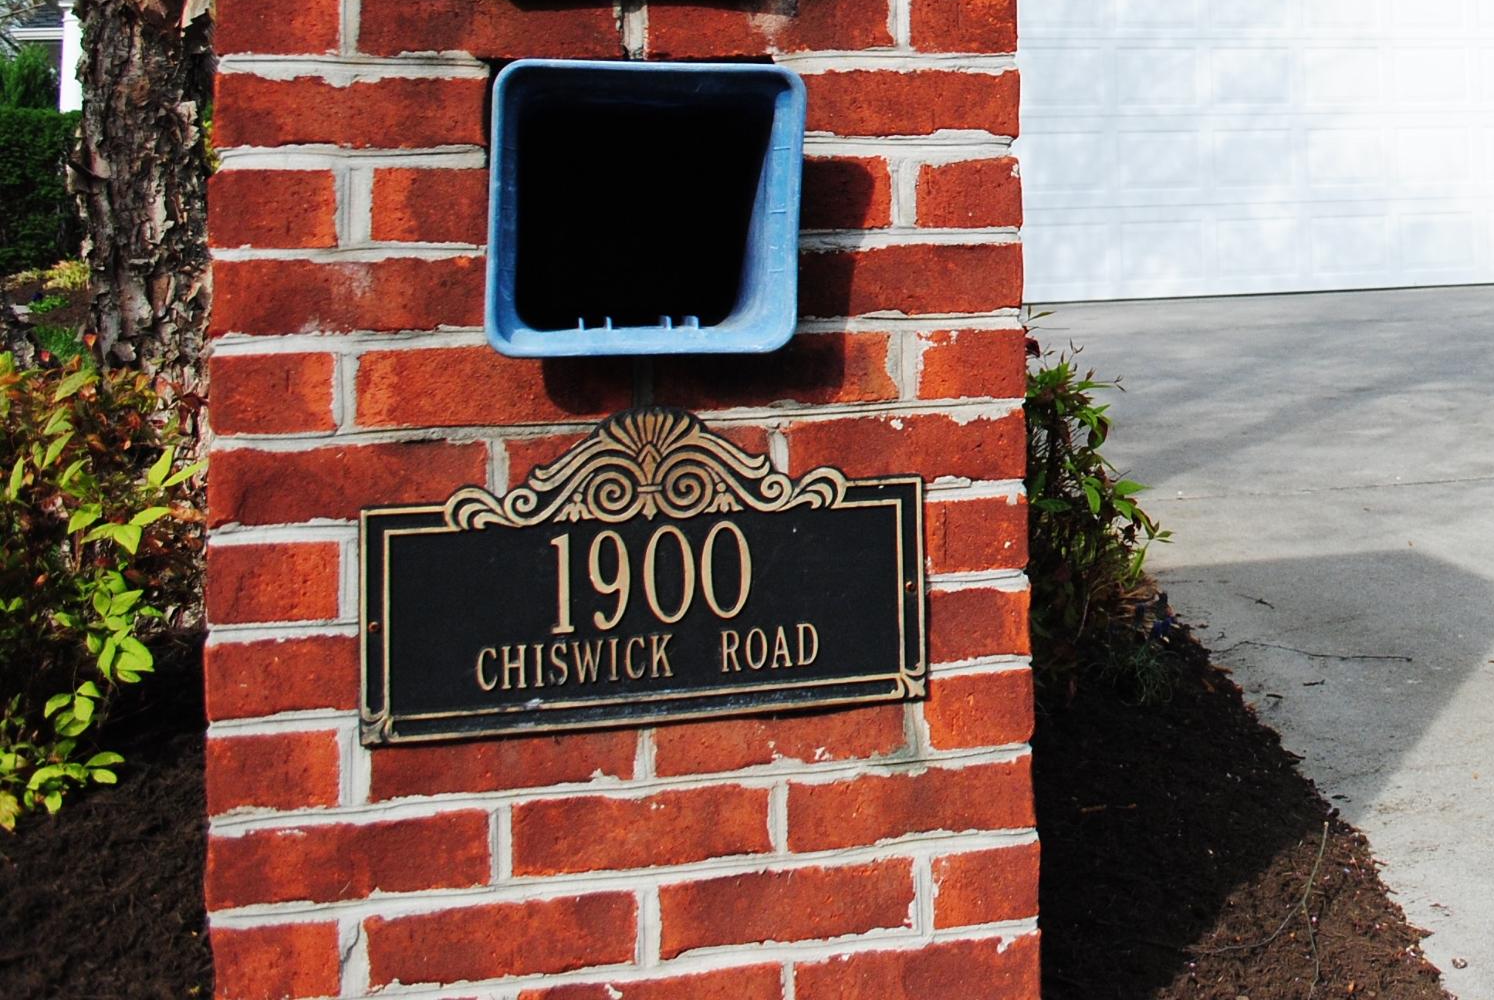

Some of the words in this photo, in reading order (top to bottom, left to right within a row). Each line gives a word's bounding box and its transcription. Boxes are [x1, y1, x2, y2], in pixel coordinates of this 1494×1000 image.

[550, 520, 752, 635] 1900
[476, 634, 674, 692] CHISWICK
[721, 623, 820, 673] ROAD
